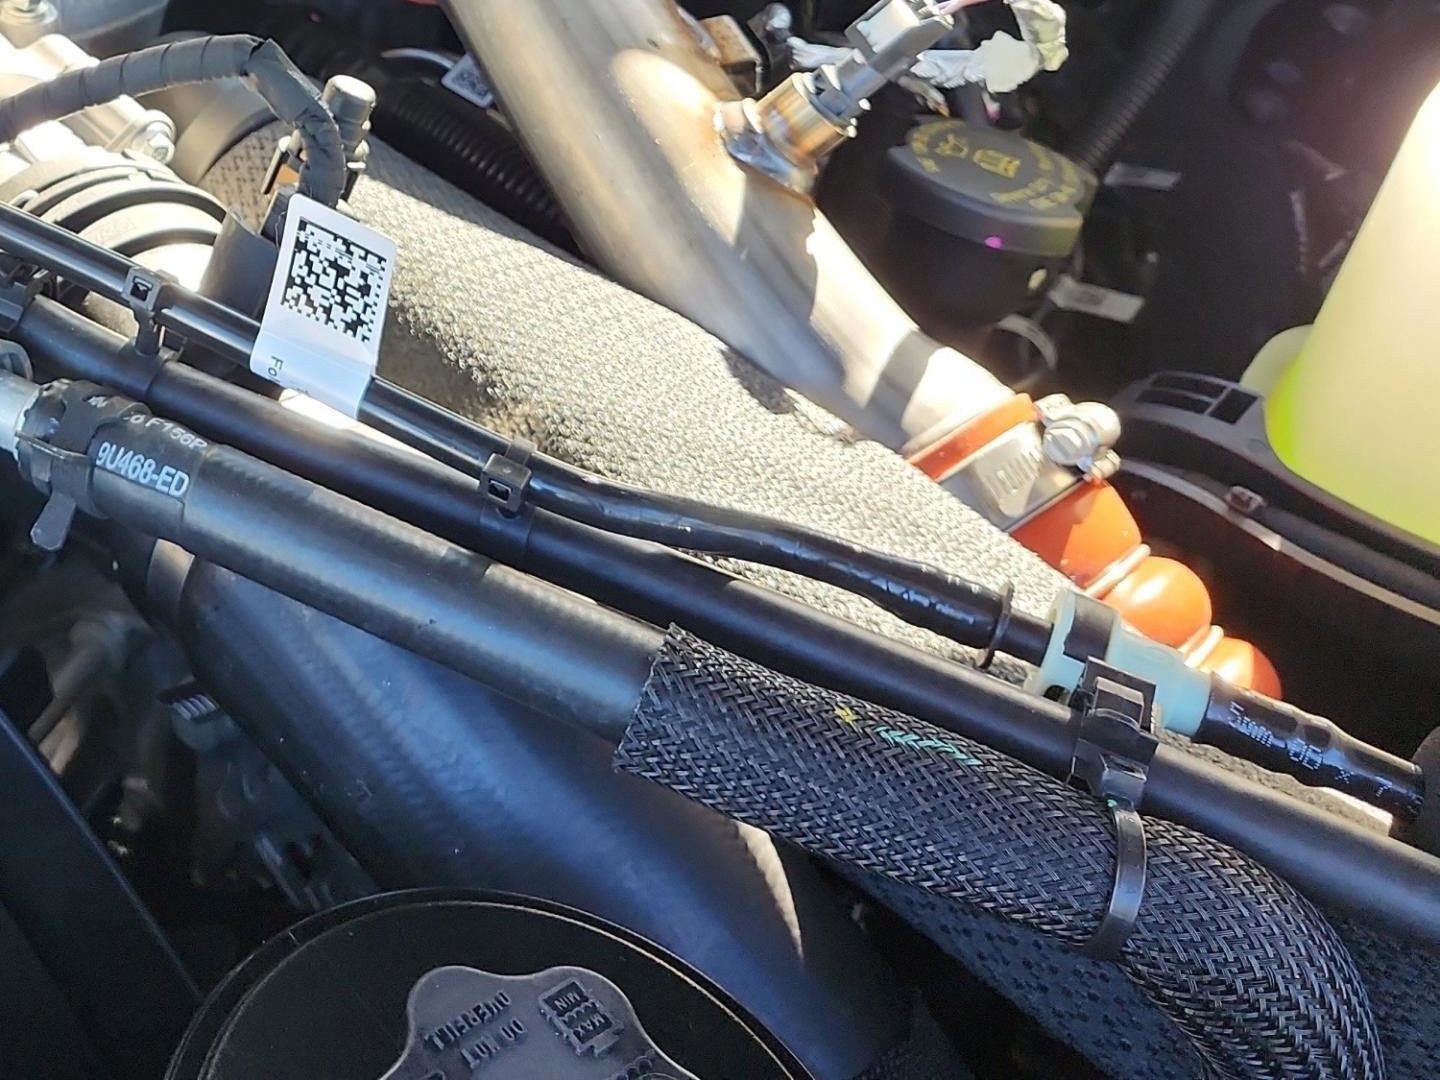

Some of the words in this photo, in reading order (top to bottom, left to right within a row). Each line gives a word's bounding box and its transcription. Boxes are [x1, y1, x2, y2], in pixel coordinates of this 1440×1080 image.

[96, 441, 189, 497] 9U468-ED
[554, 991, 581, 1011] MIN
[424, 989, 512, 1051] OVERFILL
[499, 1018, 528, 1041] DO
[572, 1013, 606, 1037] MAX
[461, 1034, 501, 1069] NOT
